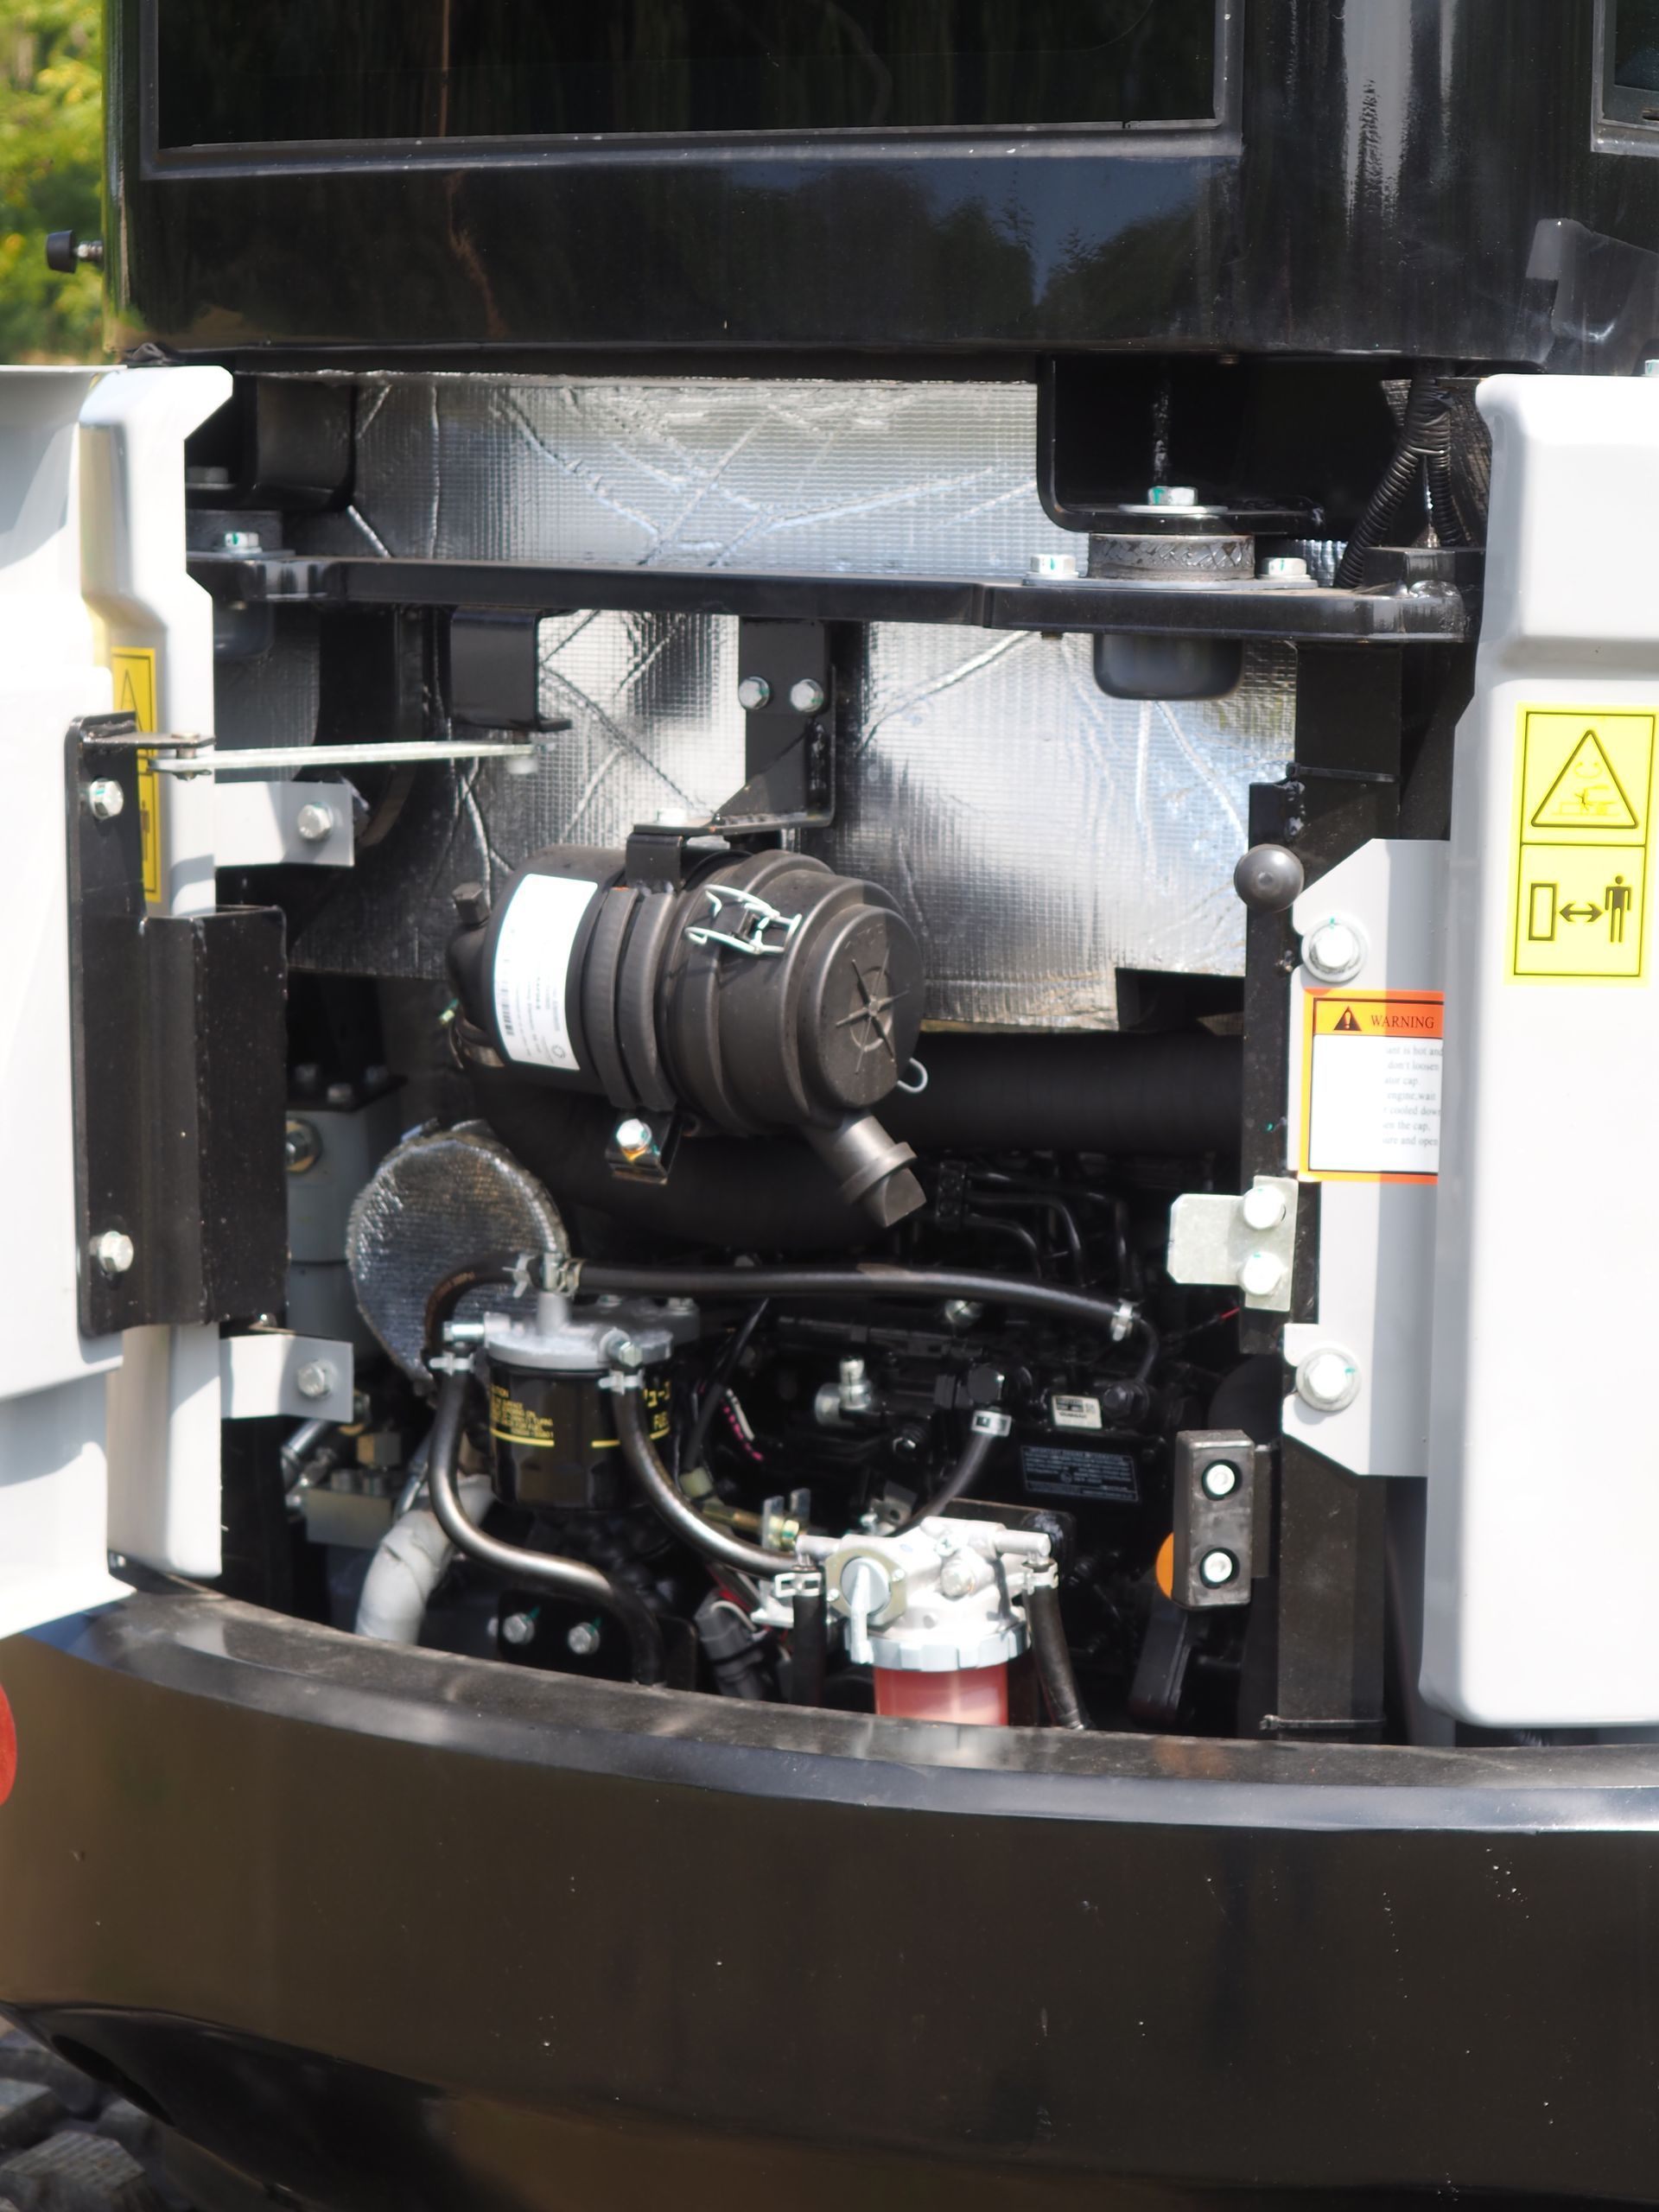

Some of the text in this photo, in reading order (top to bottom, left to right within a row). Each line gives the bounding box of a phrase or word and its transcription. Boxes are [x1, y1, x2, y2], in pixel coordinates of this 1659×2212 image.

[1370, 1014, 1435, 1029] WARNING
[1413, 1044, 1427, 1056] hot
[1412, 1059, 1440, 1071] loosen
[1389, 1106, 1418, 1116] cooled
[1397, 1120, 1411, 1130] the
[1401, 1135, 1416, 1146] and
[1418, 1137, 1439, 1148] open
